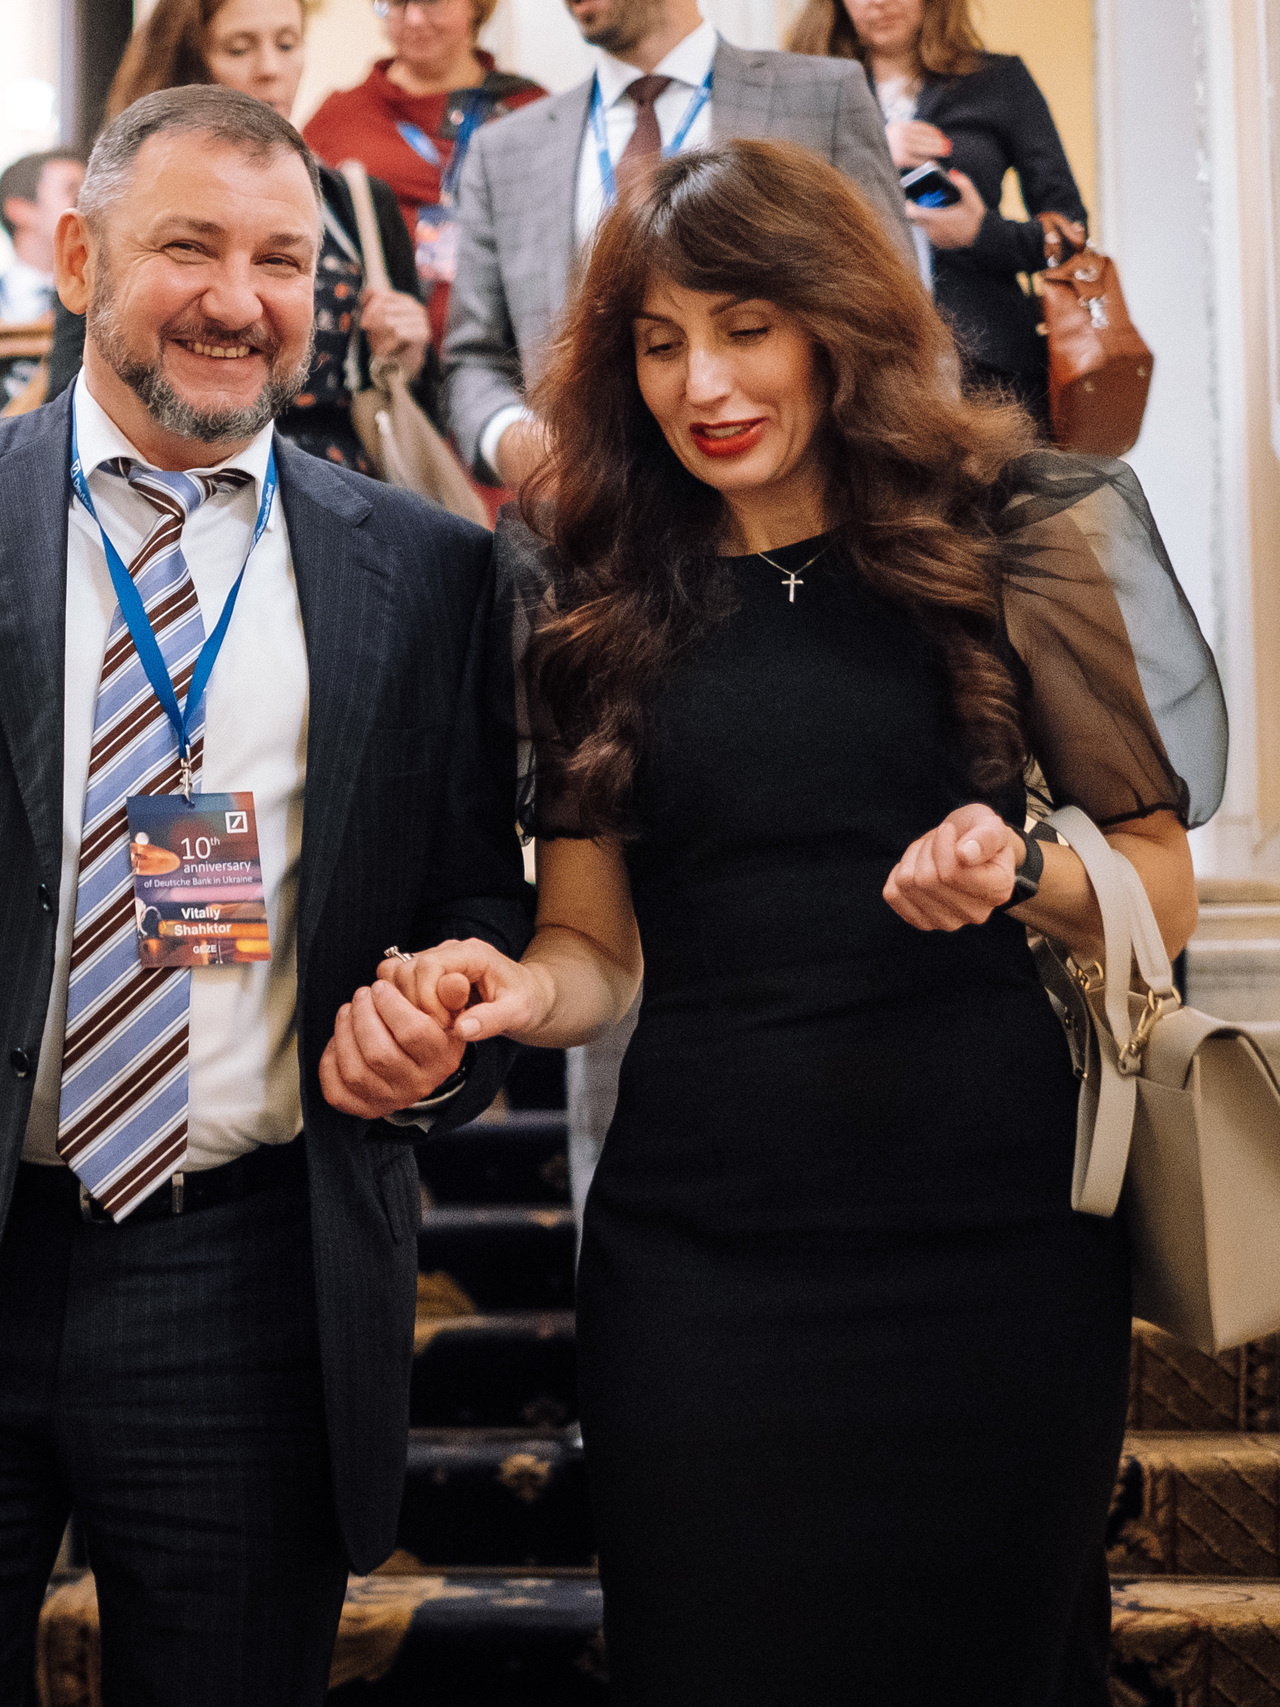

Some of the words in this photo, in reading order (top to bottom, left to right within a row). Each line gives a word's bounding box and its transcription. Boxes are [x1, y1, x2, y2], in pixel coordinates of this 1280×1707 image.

[183, 861, 251, 874] anniversary
[144, 879, 153, 888] of
[154, 878, 191, 887] Deutsche
[193, 877, 211, 886] Bank
[213, 876, 221, 884] in
[222, 875, 253, 884] Ukraine
[174, 924, 231, 936] Shahktor
